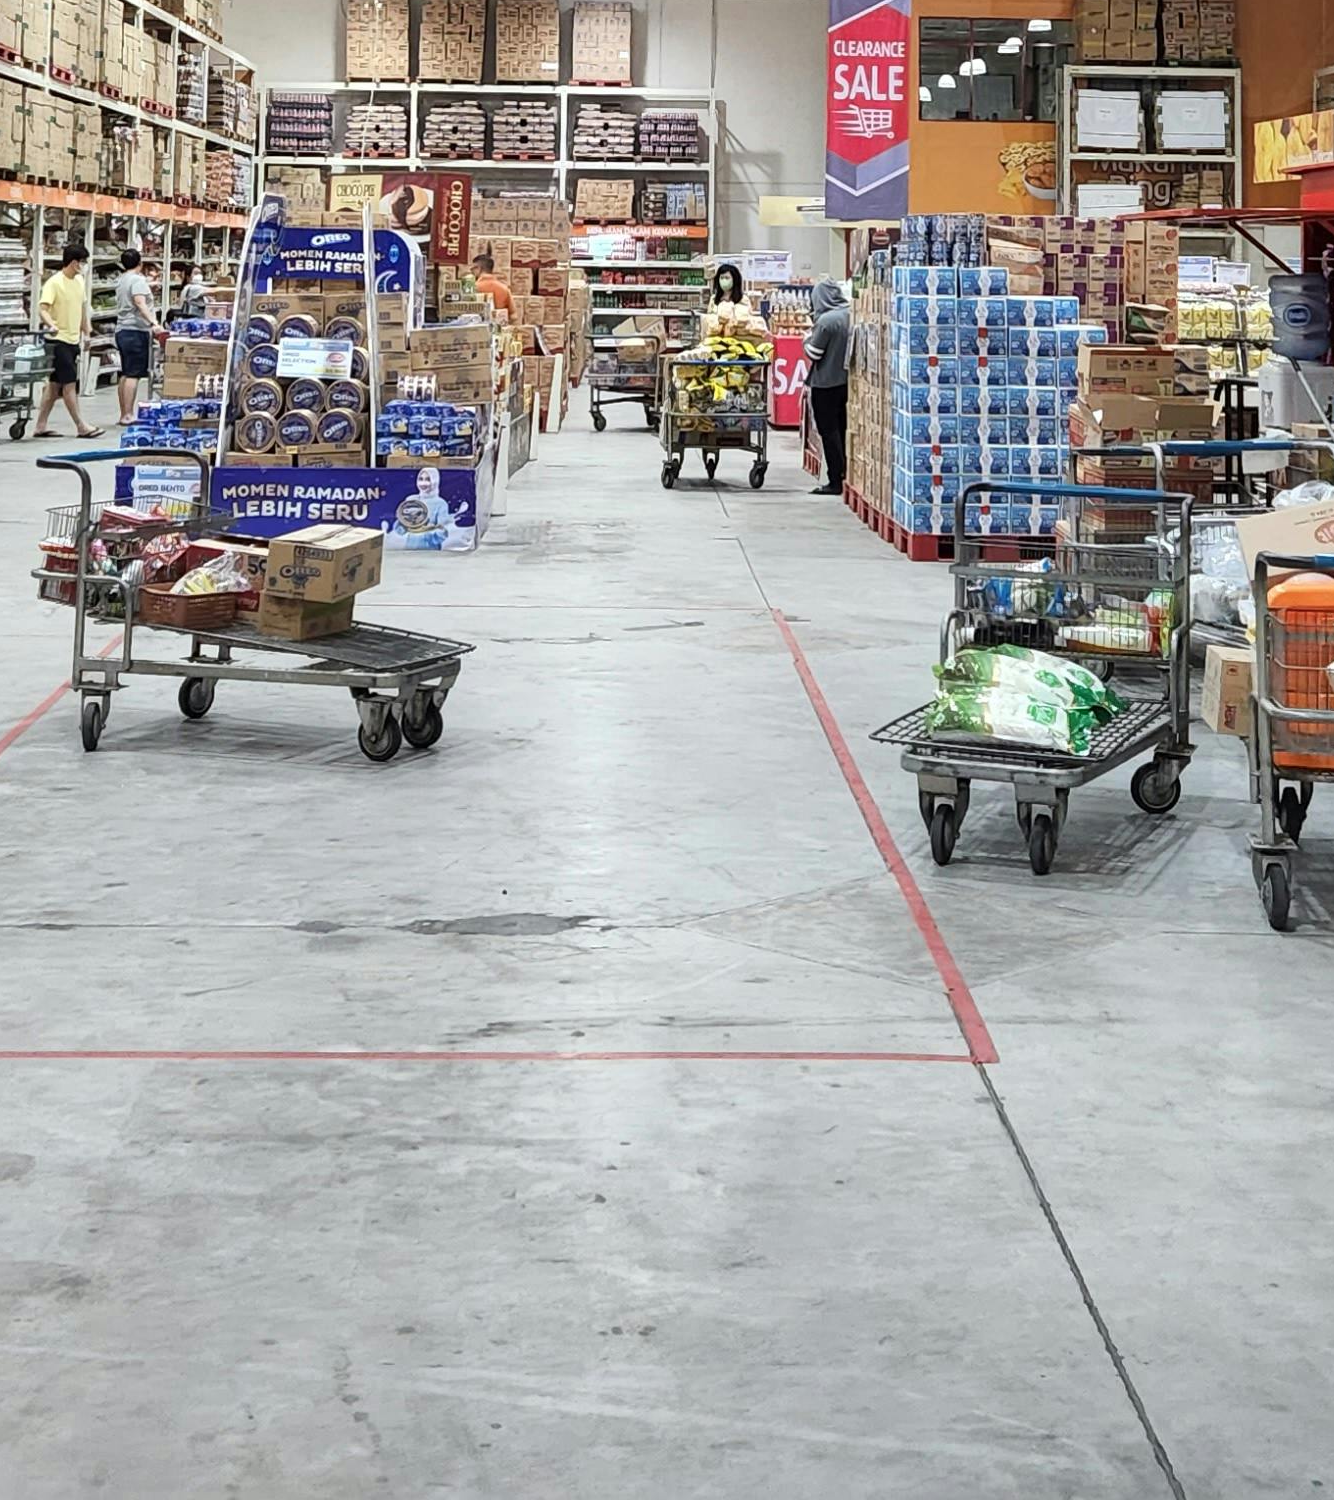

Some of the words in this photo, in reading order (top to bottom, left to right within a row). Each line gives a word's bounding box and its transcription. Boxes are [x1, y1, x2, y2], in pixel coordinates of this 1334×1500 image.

[833, 40, 905, 58] CLEARANCE
[833, 64, 903, 101] SALE
[447, 180, 464, 231] CHOCO
[311, 233, 351, 246] OREO
[280, 250, 323, 260] MOMEN
[287, 260, 330, 272] LEBIH
[223, 483, 289, 499] MOMEN
[293, 485, 380, 500] RAMADAN
[232, 500, 301, 519] LEBIH
[307, 503, 368, 520] SERU
